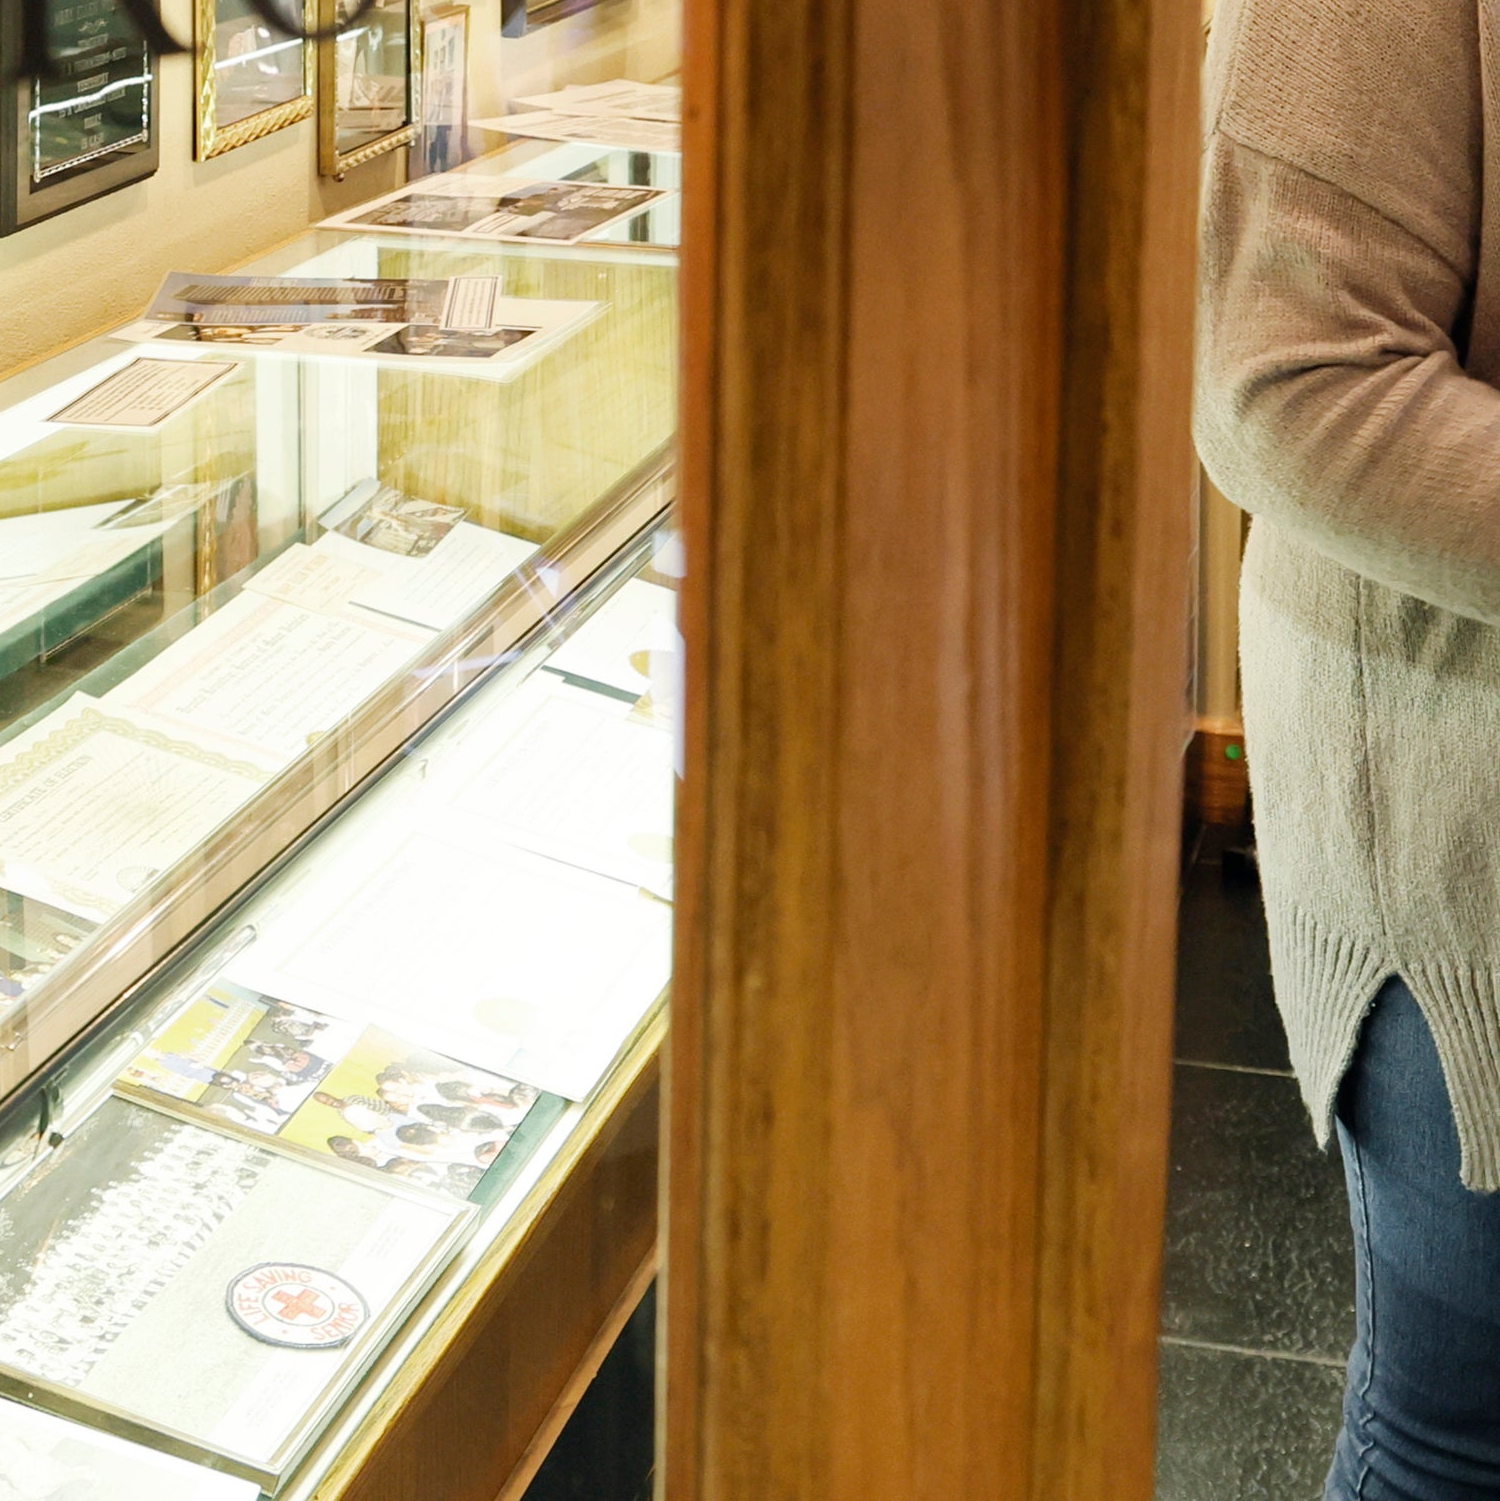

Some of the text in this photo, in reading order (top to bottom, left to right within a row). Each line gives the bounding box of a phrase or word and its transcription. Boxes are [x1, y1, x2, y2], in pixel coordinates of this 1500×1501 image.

[238, 1269, 312, 1325] LIFE SAVING
[311, 1302, 359, 1341] SENIOR
